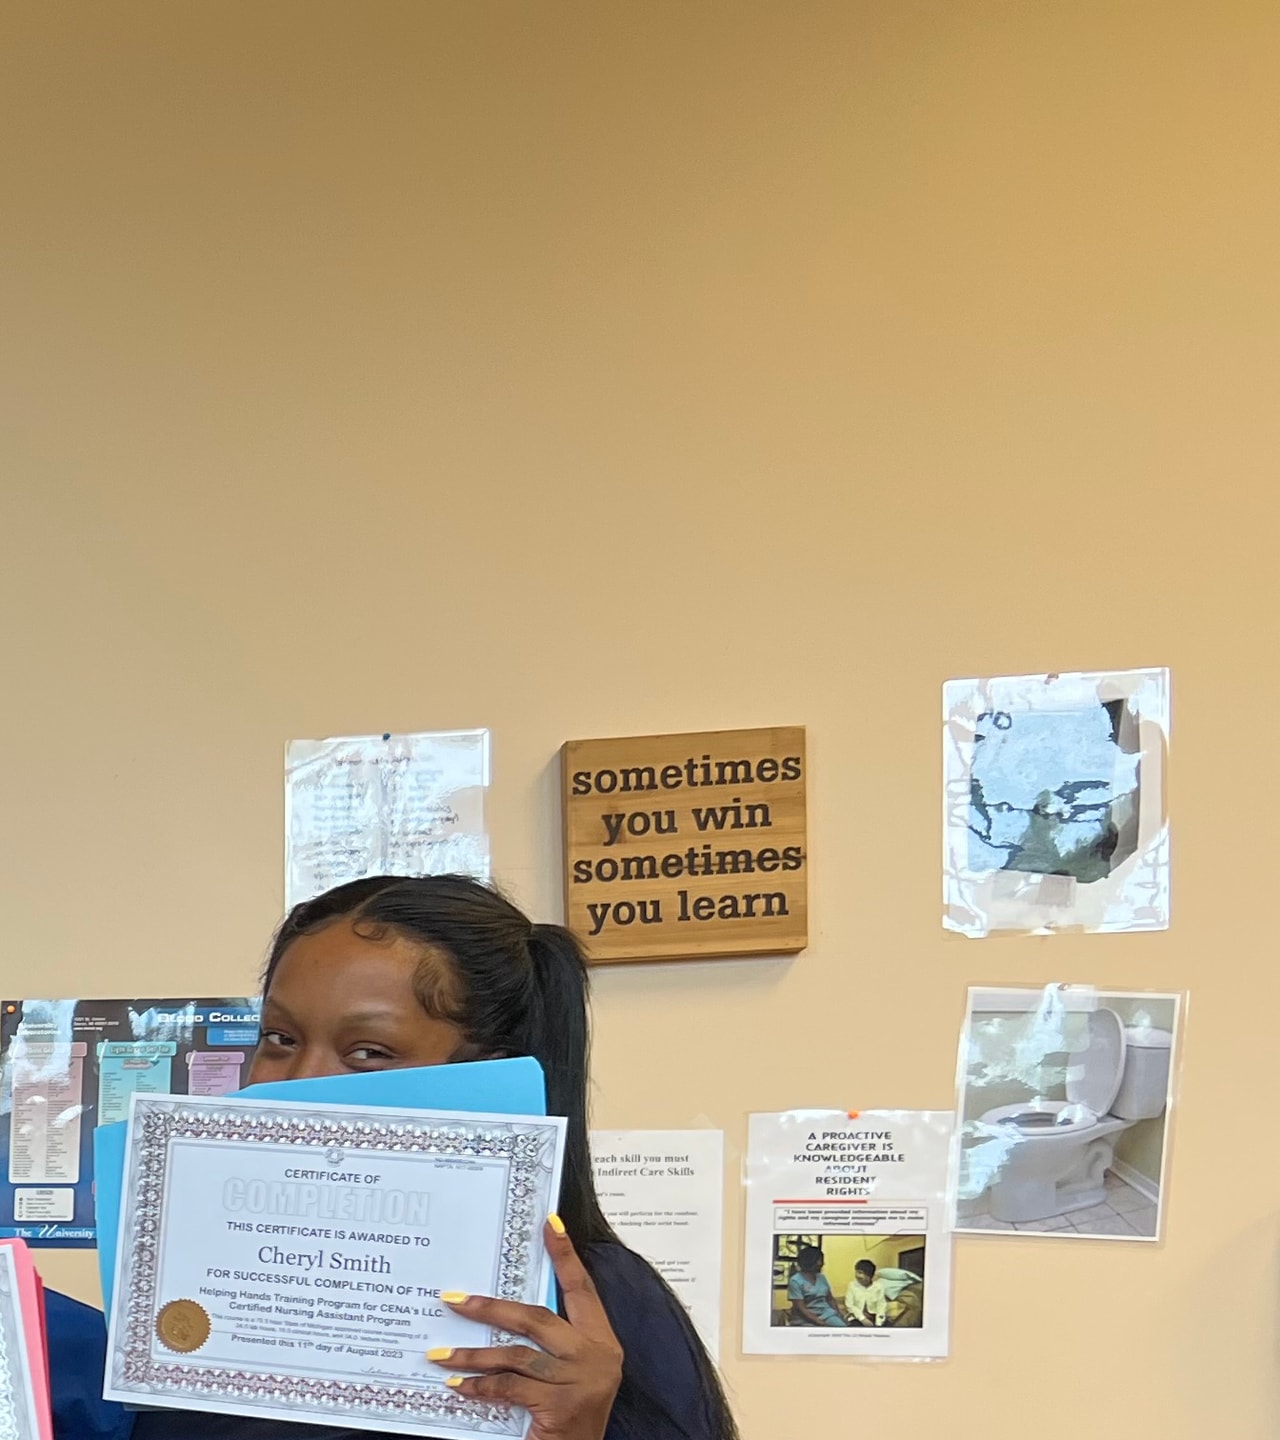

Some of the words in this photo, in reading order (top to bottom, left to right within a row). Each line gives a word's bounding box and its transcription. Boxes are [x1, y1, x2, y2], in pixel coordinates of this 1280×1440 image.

[572, 754, 802, 796] sometimes
[602, 809, 676, 846] you
[691, 798, 772, 831] win
[573, 844, 802, 885] sometimes
[587, 898, 662, 936] you
[677, 887, 789, 922] learn
[806, 1143, 876, 1151] CAREGIVER
[882, 1143, 893, 1151] IS
[808, 1132, 816, 1140] A
[822, 1132, 892, 1140] PROACTIVE
[595, 1154, 617, 1163] each
[620, 1154, 641, 1163] skill
[644, 1156, 661, 1165] you
[664, 1155, 689, 1163] must
[793, 1154, 905, 1162] KNOWLEDGEABLE
[284, 1168, 362, 1183] CERTIFICATE
[363, 1174, 381, 1184] OF
[598, 1168, 637, 1176] Indirect
[640, 1168, 665, 1176] Care
[667, 1167, 695, 1176] Skills
[815, 1176, 877, 1184] RESIDENT
[222, 1177, 431, 1227] COMPLETION
[826, 1187, 870, 1196] RIGHTS
[14, 1228, 32, 1237] The
[38, 1224, 95, 1239] University
[226, 1220, 253, 1232] THIS
[255, 1223, 332, 1239] CERTIFICATE
[334, 1229, 346, 1240] IS
[347, 1231, 411, 1245] AWARDED
[413, 1236, 430, 1247] TO
[258, 1245, 323, 1271] Cheryl
[329, 1251, 391, 1274] Smith
[206, 1267, 231, 1279] FOR
[233, 1270, 311, 1286] SUCCESSFUL
[314, 1277, 394, 1294] COMPLETION
[396, 1285, 413, 1295] OF
[416, 1287, 441, 1299] THE
[198, 1286, 237, 1300] Helping
[239, 1290, 271, 1301] Hands
[273, 1293, 315, 1307] Training
[316, 1297, 361, 1310] Program
[362, 1301, 378, 1311] for
[228, 1301, 273, 1313] Certified
[274, 1305, 314, 1319] Nursing
[315, 1309, 365, 1322] Assistant
[365, 1314, 411, 1327] Program
